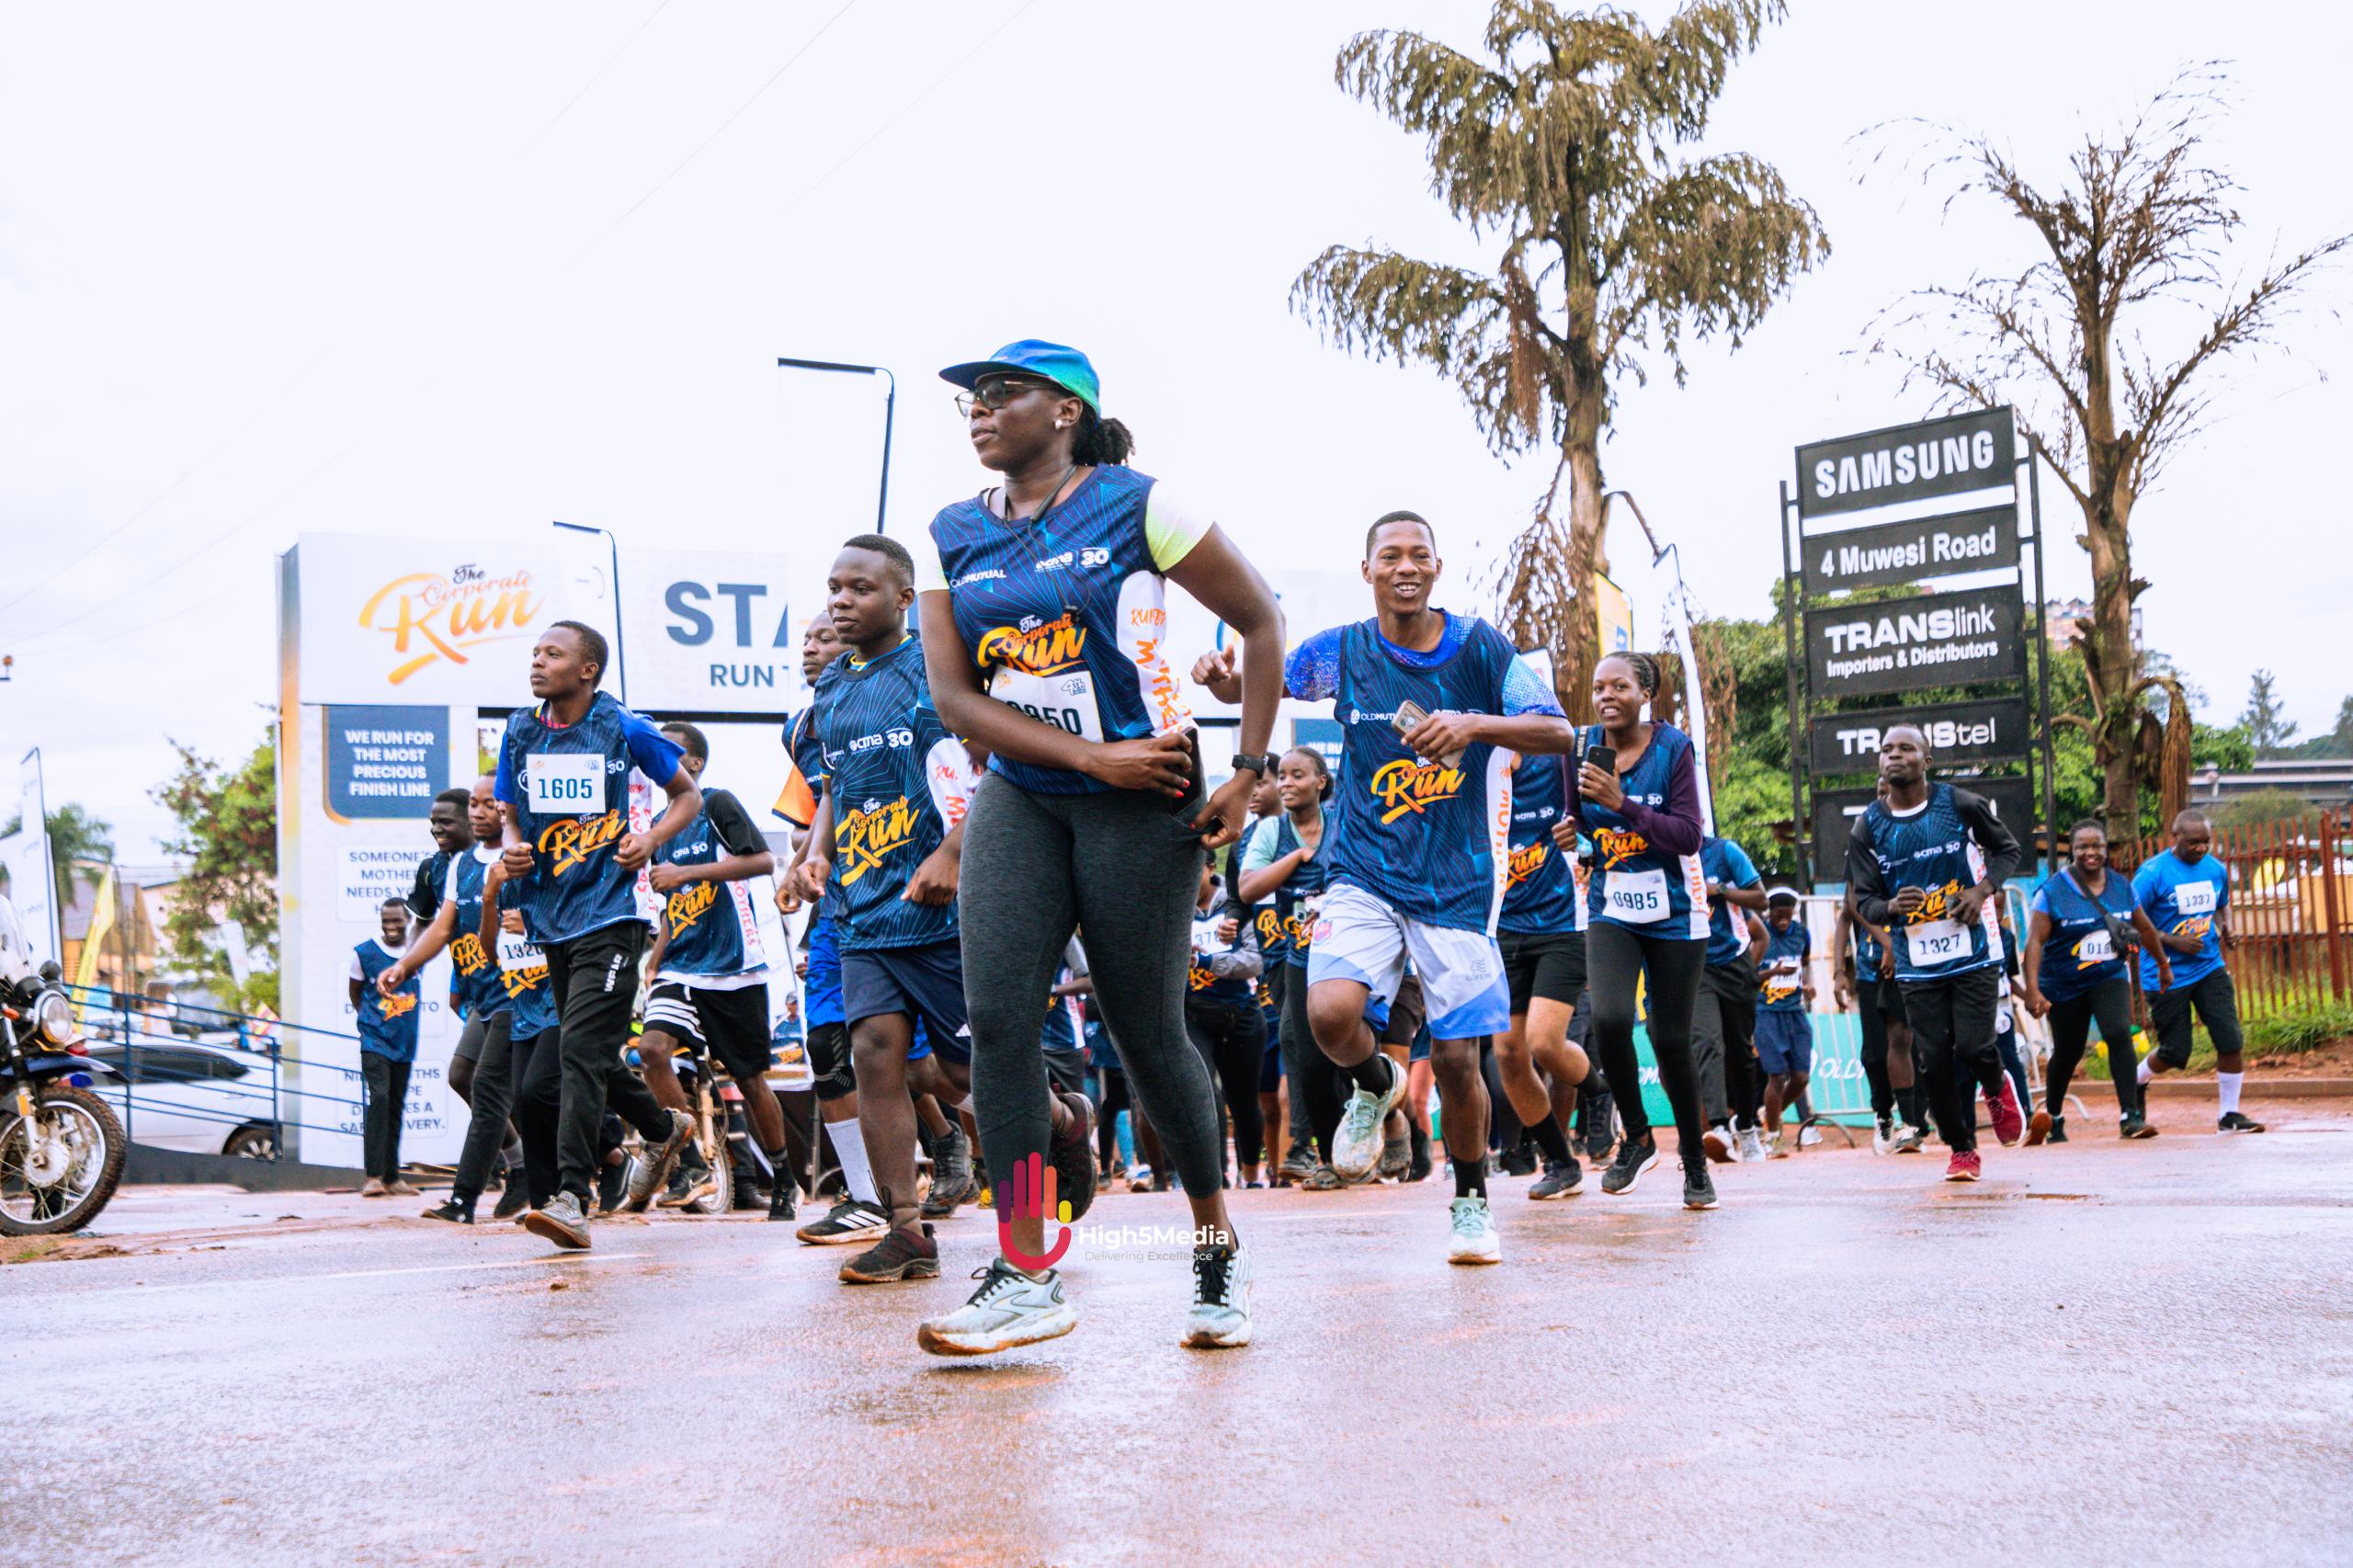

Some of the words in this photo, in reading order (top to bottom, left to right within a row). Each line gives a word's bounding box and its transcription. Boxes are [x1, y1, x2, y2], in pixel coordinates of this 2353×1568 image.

[1814, 429, 1995, 498] SAMSUNG
[1081, 550, 1109, 566] 30
[1820, 549, 1836, 578] 4
[1840, 535, 1927, 576] Muwesi
[1932, 525, 1996, 562] Road
[452, 562, 485, 585] The
[358, 573, 550, 686] Run
[1019, 614, 1044, 633] The
[1824, 603, 1996, 654] TRANSlink
[1826, 655, 1894, 679] Importers
[1896, 649, 1908, 668] &
[1910, 640, 1999, 666] Distributors
[709, 664, 774, 687] RUN
[1006, 700, 1083, 735] 50
[1360, 712, 1397, 721] OLDMUT
[345, 730, 369, 744] WE
[371, 730, 403, 745] RUN
[404, 731, 435, 745] FOR
[886, 730, 914, 748] 30
[1836, 716, 1996, 756] TRStel
[353, 748, 381, 762] THE
[384, 748, 427, 763] MOST
[353, 765, 427, 779] PRECIOUS
[606, 759, 625, 775] 30
[349, 781, 398, 797] FINISH
[400, 782, 431, 798] LINE
[539, 778, 594, 800] 1605
[1370, 759, 1467, 825] Run
[863, 796, 881, 815] The
[538, 818, 628, 878] Run
[691, 841, 709, 855] 30
[835, 808, 919, 886] Run
[347, 886, 392, 898] NEEDS
[1613, 891, 1658, 911] 0985
[1918, 933, 1961, 956] 1327
